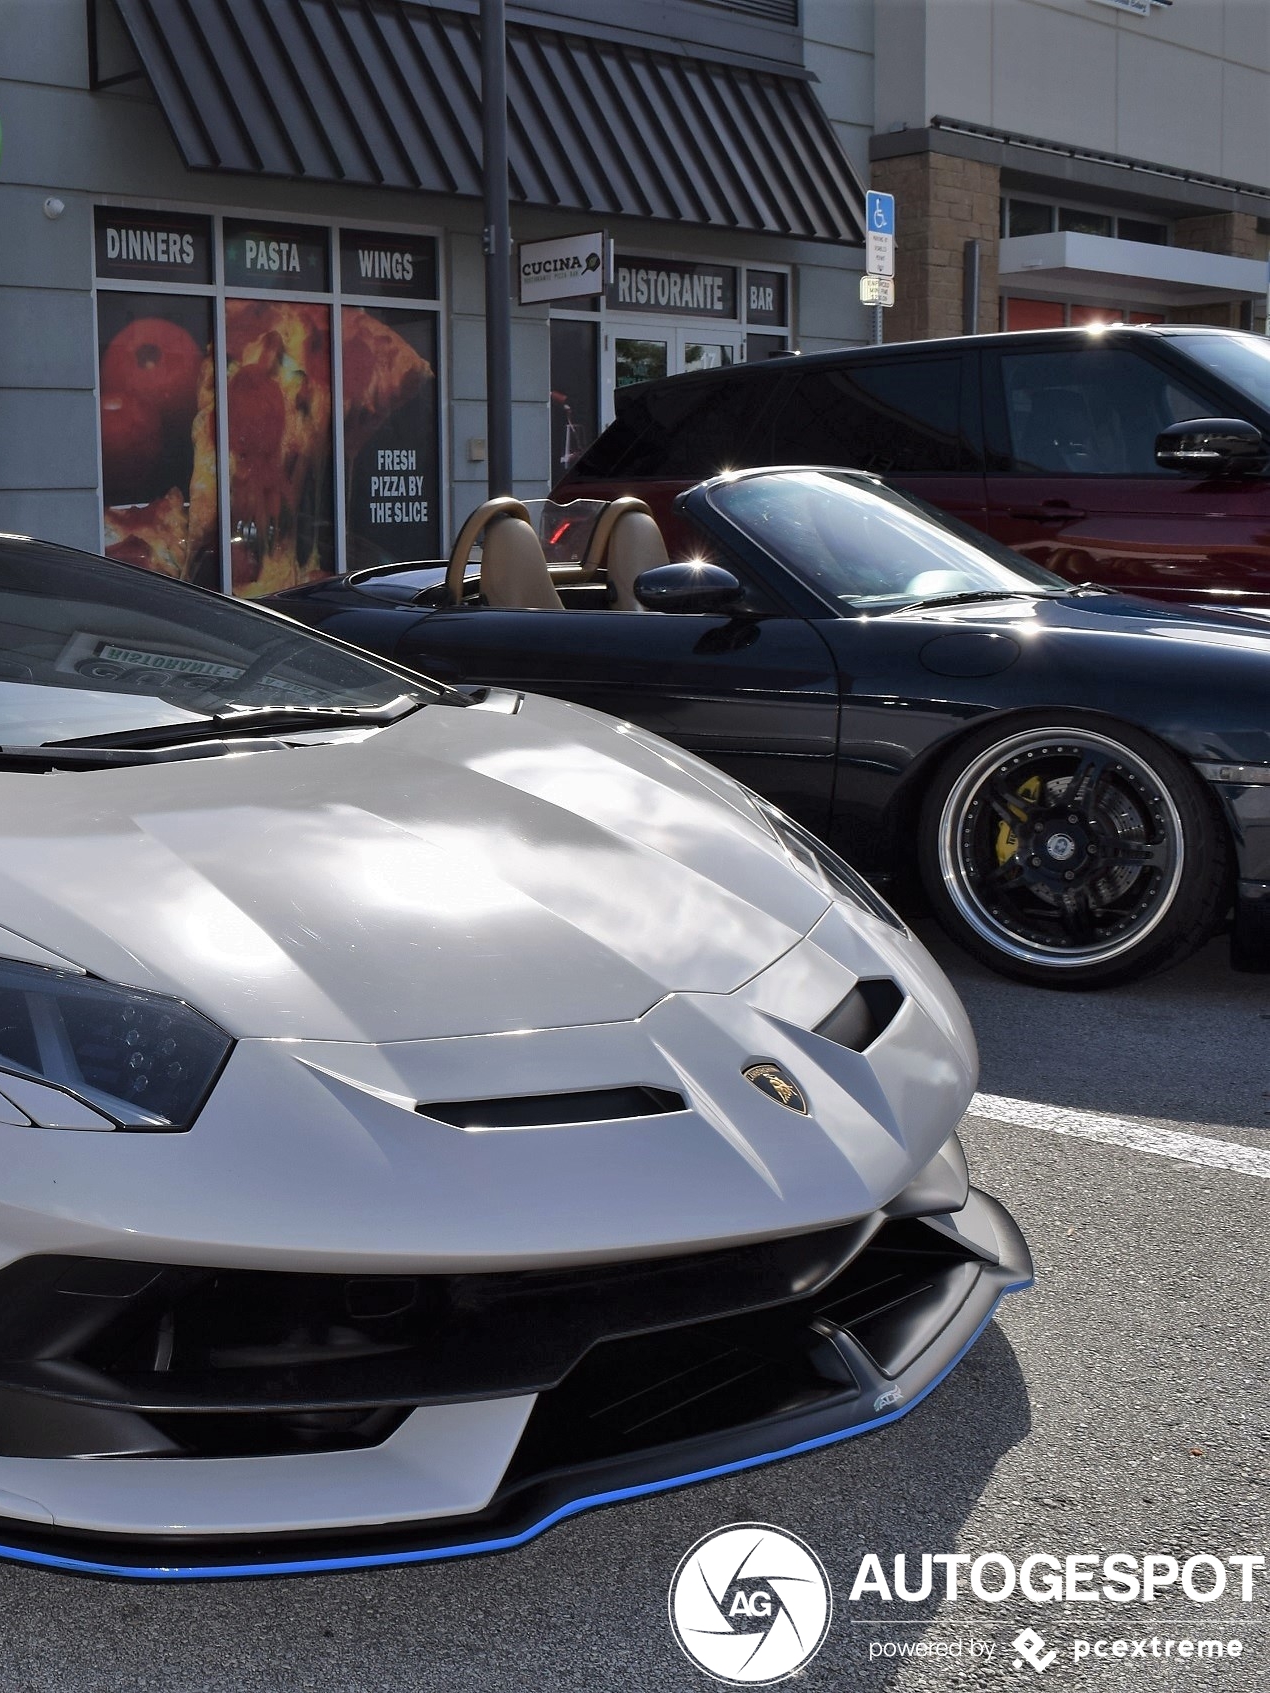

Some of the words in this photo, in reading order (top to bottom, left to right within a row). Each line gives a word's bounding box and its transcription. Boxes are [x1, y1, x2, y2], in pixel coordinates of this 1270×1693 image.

[106, 228, 194, 264] DINNERS
[245, 239, 301, 273] PASTA
[359, 249, 414, 281] WINGS
[522, 256, 582, 276] CUCINA
[618, 267, 723, 310] RISTORANTE
[749, 286, 774, 311] BAR
[377, 449, 417, 471] FRESH
[371, 475, 405, 498] PIZZA
[408, 475, 424, 496] BY
[370, 502, 393, 523] THE
[394, 501, 428, 523] SLICE
